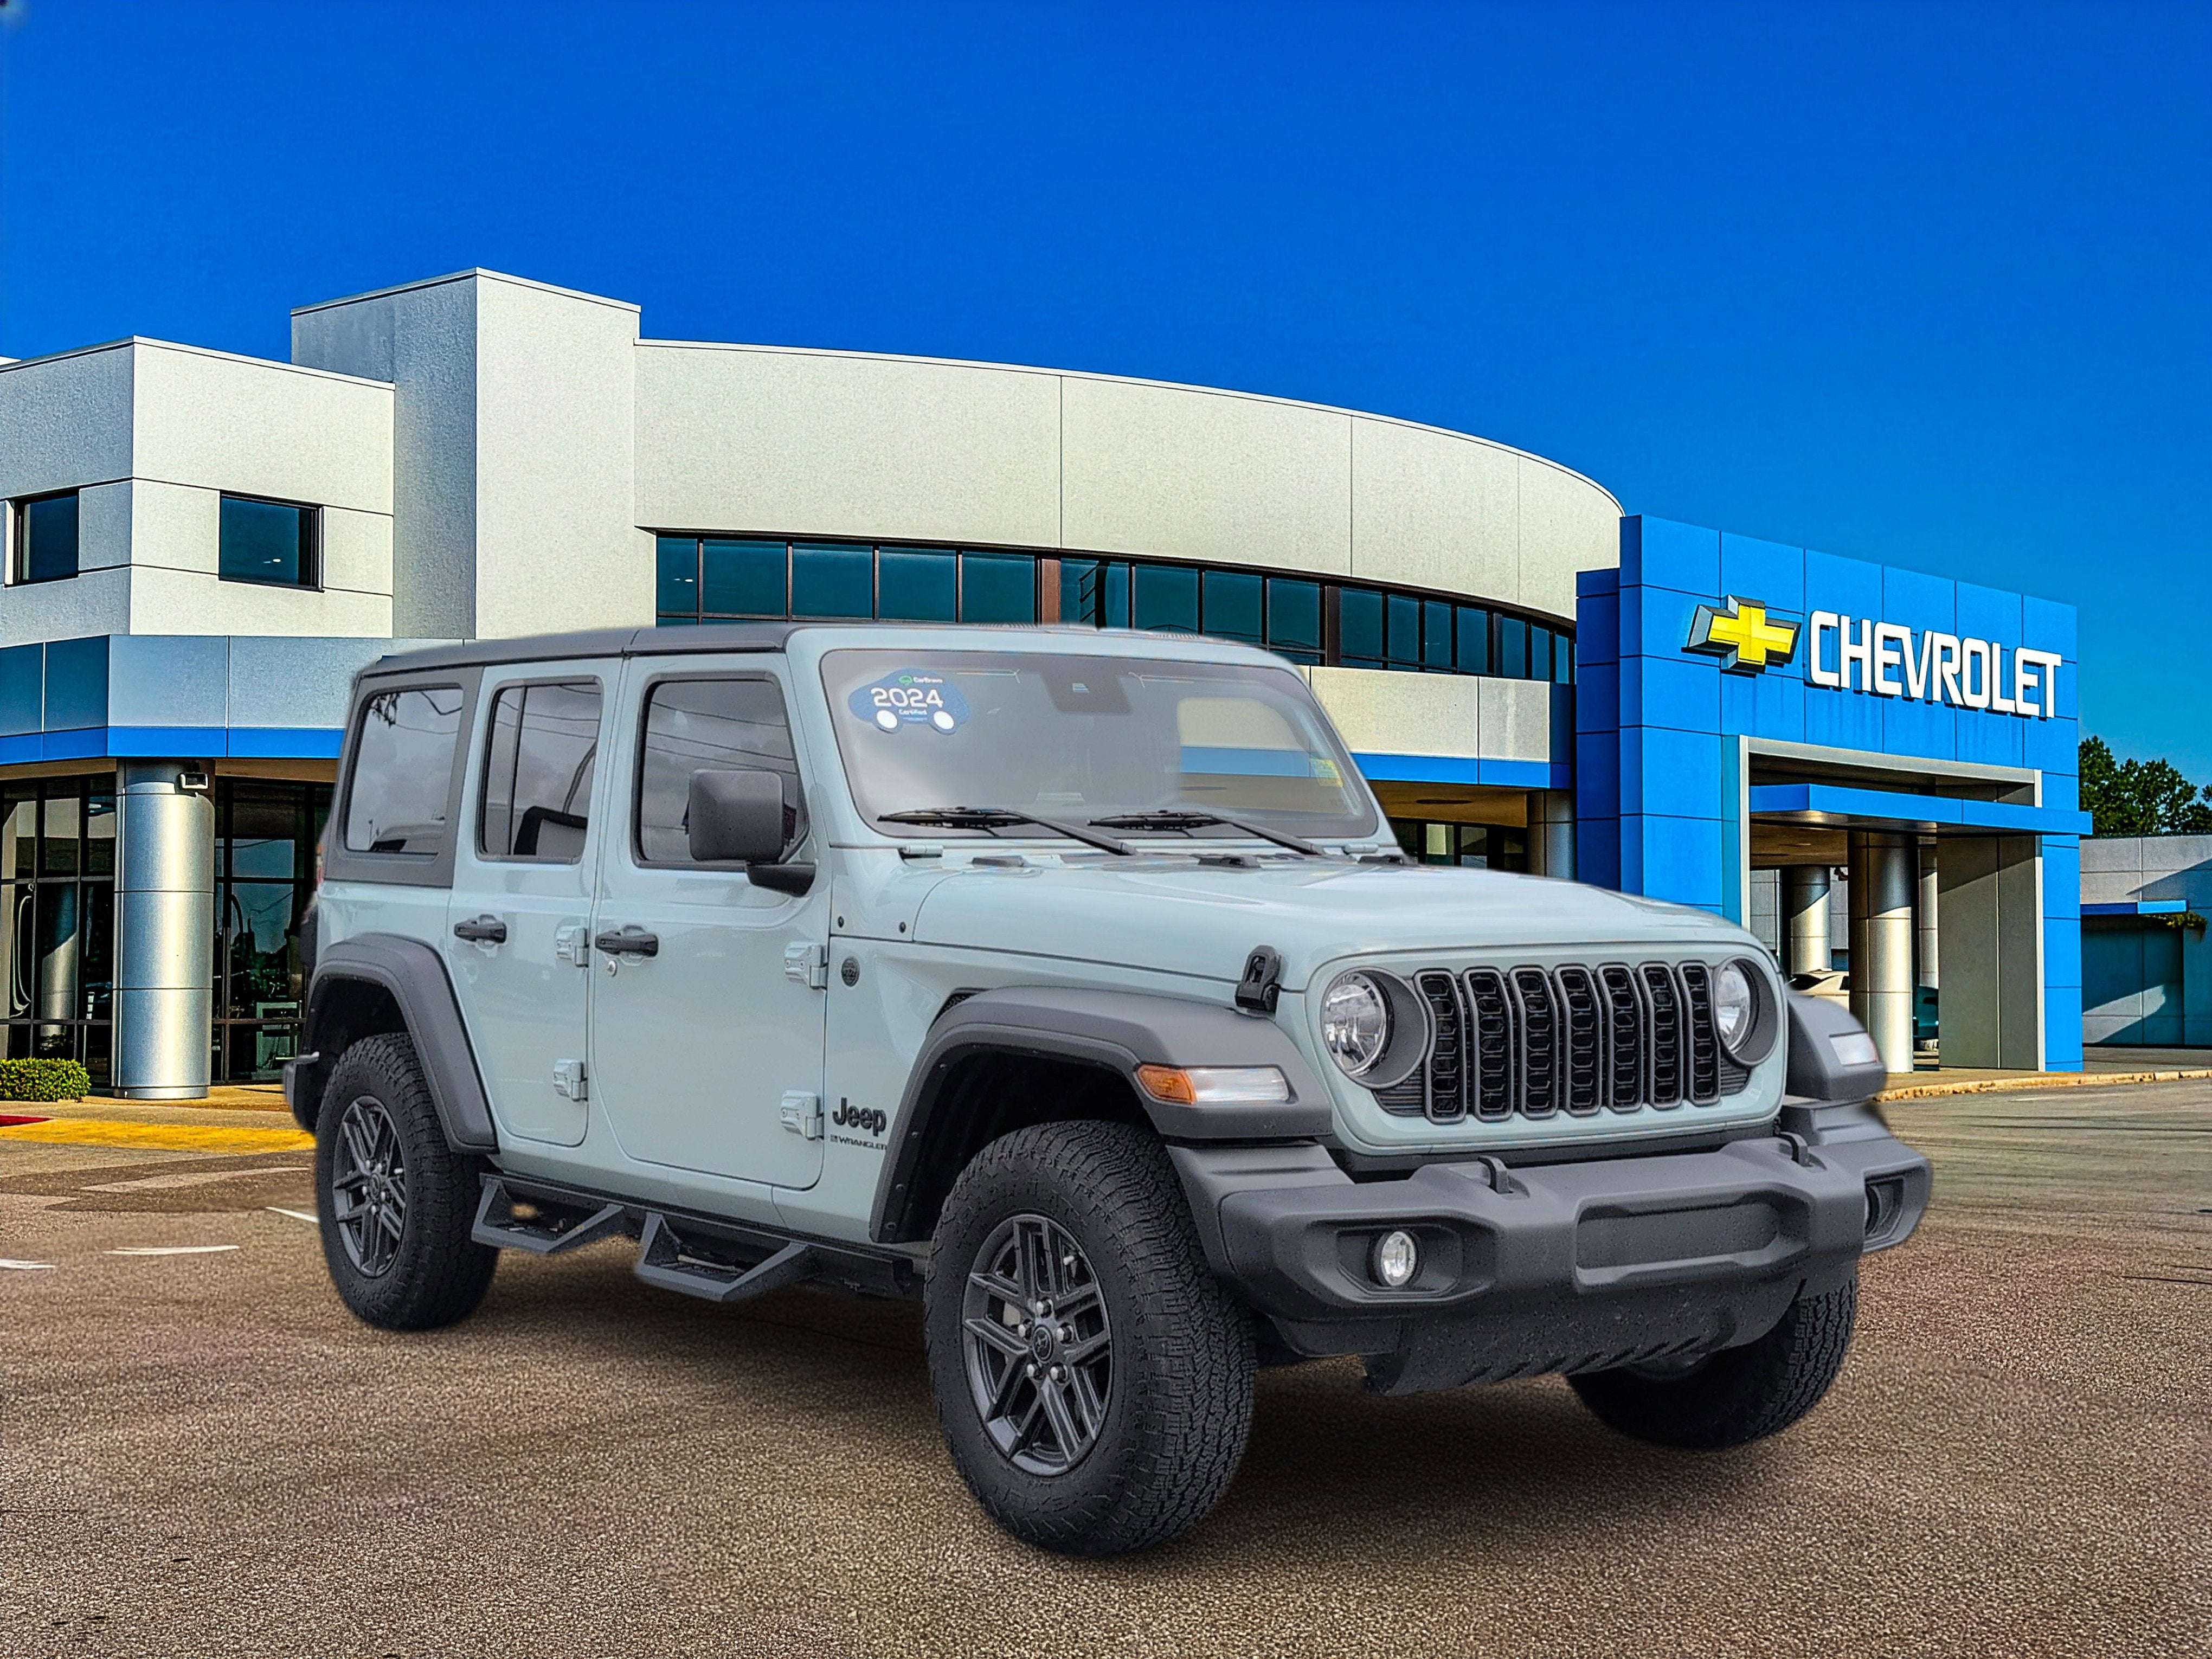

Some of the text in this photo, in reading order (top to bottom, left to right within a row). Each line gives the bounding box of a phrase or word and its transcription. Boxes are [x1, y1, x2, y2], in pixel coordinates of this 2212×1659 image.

[1810, 610, 2062, 718] CHEVROLET
[870, 687, 944, 708] 2024
[832, 1097, 886, 1137] Jeep
